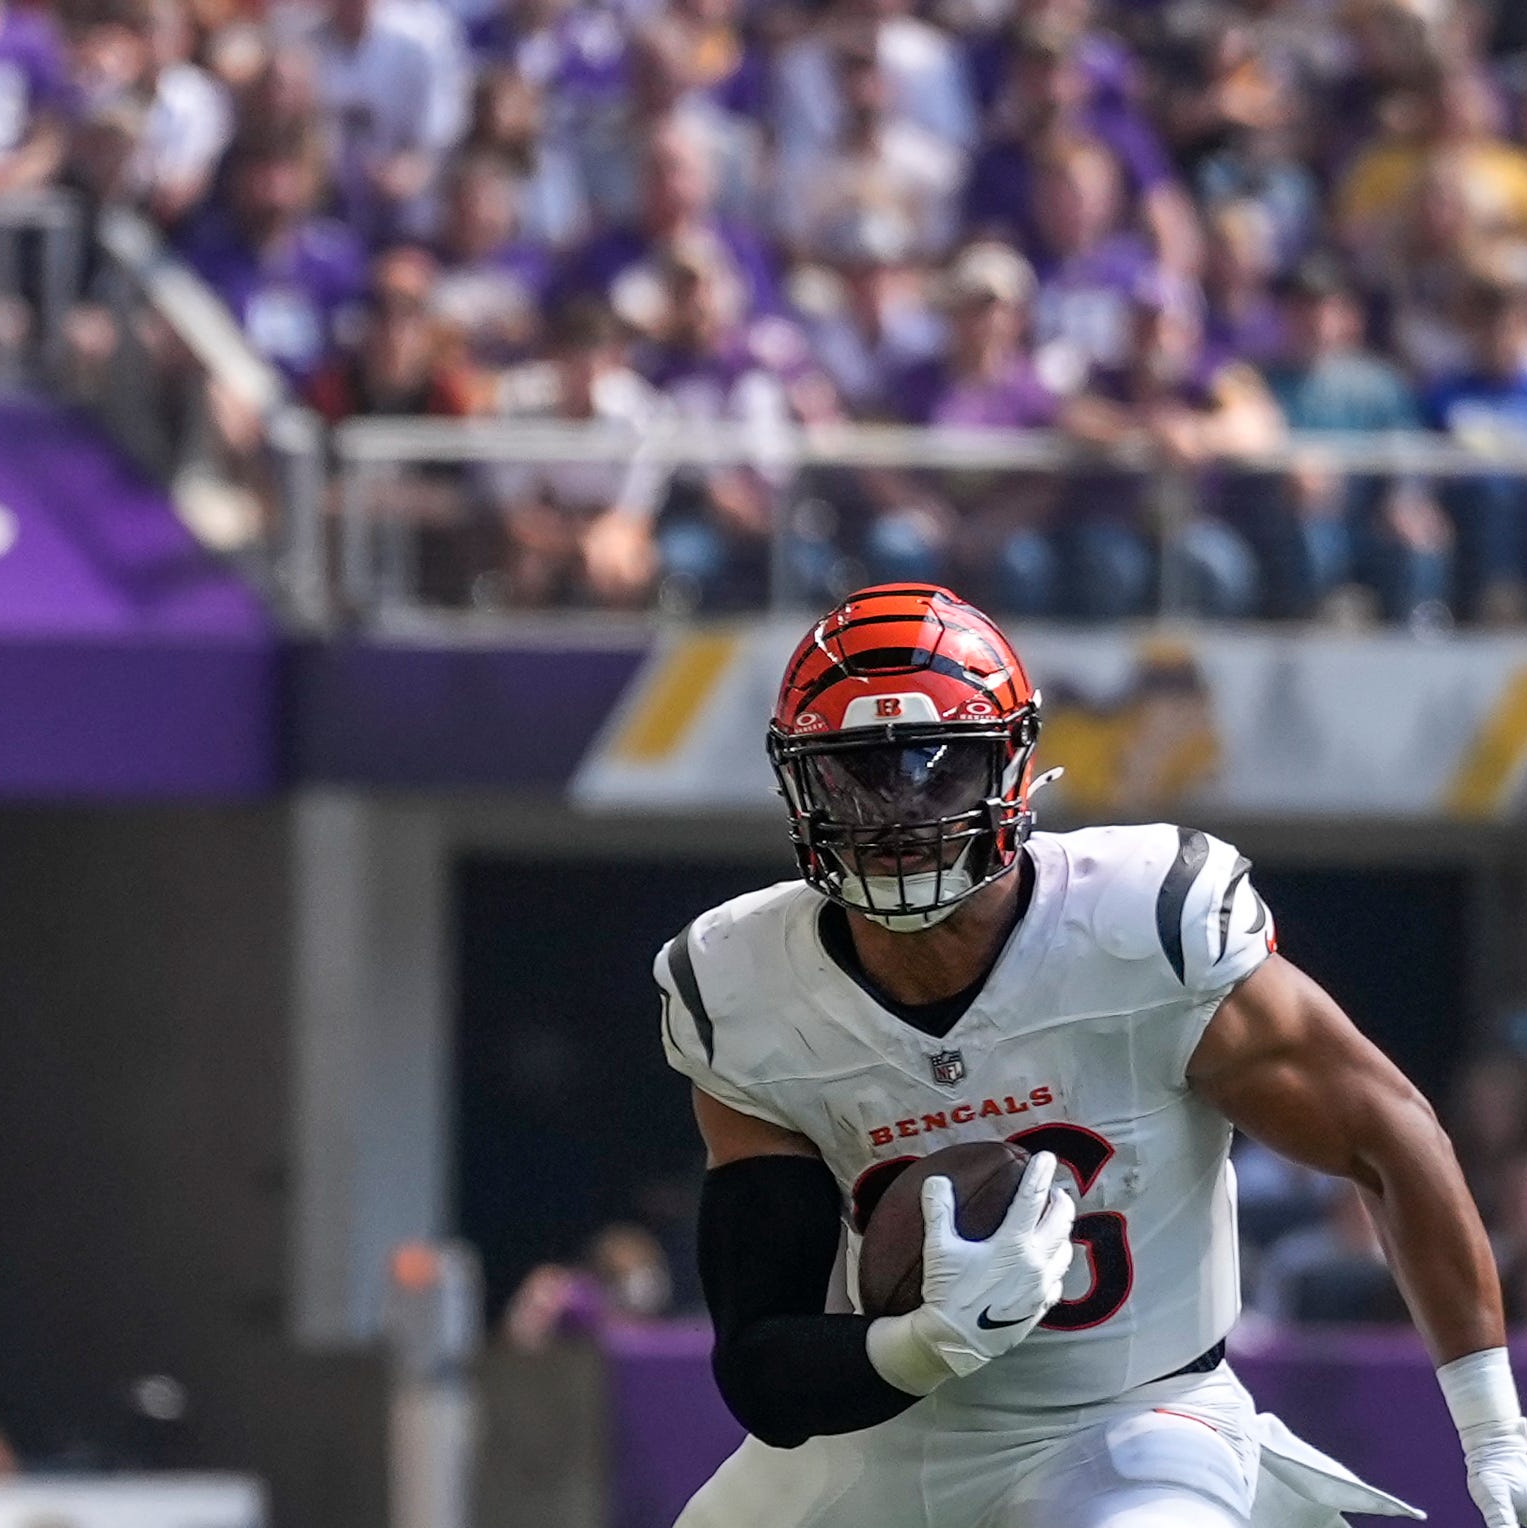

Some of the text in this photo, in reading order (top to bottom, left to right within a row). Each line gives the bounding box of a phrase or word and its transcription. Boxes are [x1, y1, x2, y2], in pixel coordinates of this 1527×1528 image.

[936, 1062, 962, 1080] NFL
[868, 1086, 1053, 1146] BENGALS
[851, 1122, 1133, 1331] 6
